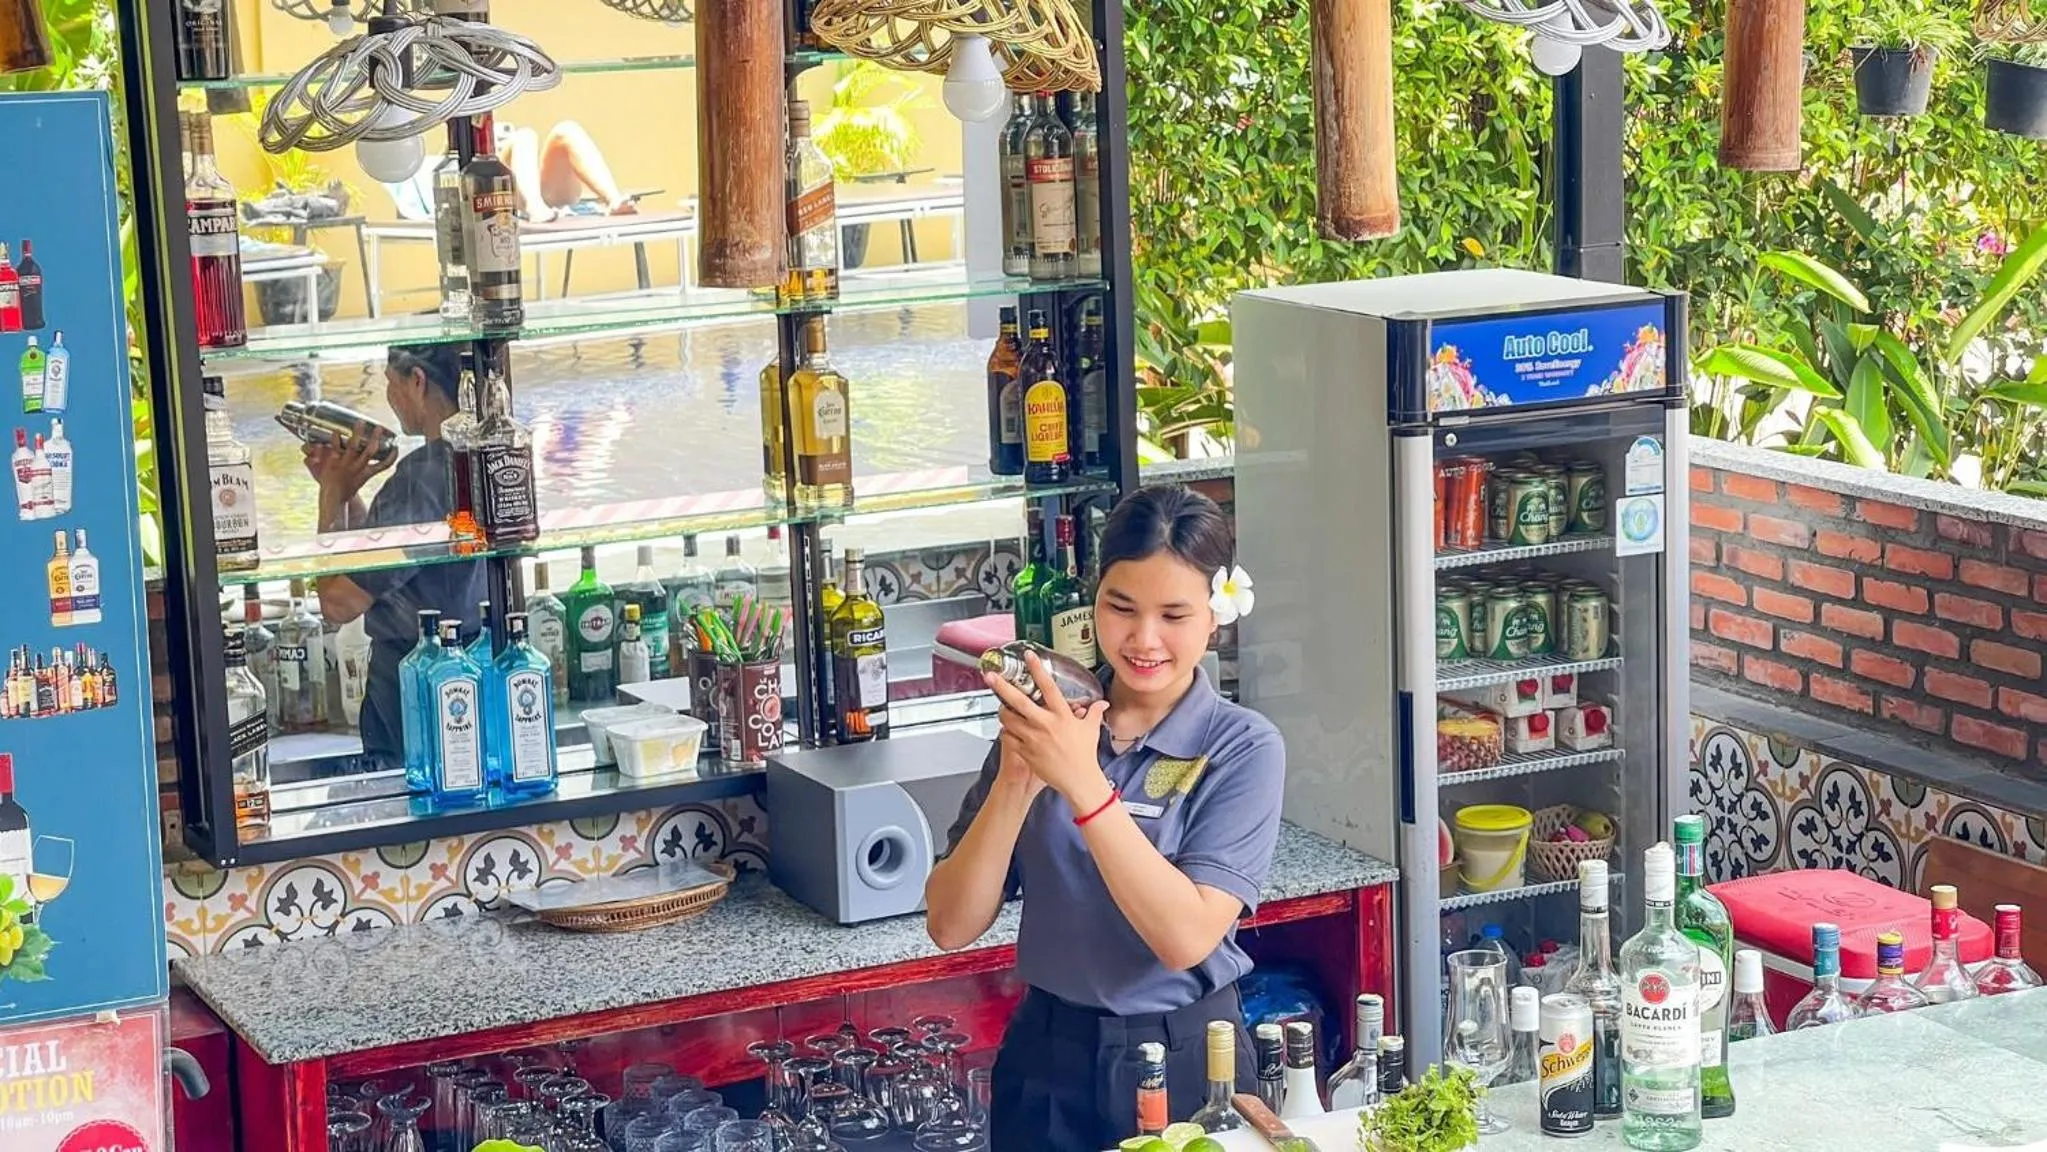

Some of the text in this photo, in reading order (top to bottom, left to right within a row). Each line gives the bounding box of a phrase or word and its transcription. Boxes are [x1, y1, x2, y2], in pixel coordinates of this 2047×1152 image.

[1503, 334, 1546, 360] Auto
[487, 457, 504, 475] JACK
[1626, 1002, 1687, 1021] BACARDÍ
[0, 1039, 66, 1079] IAL
